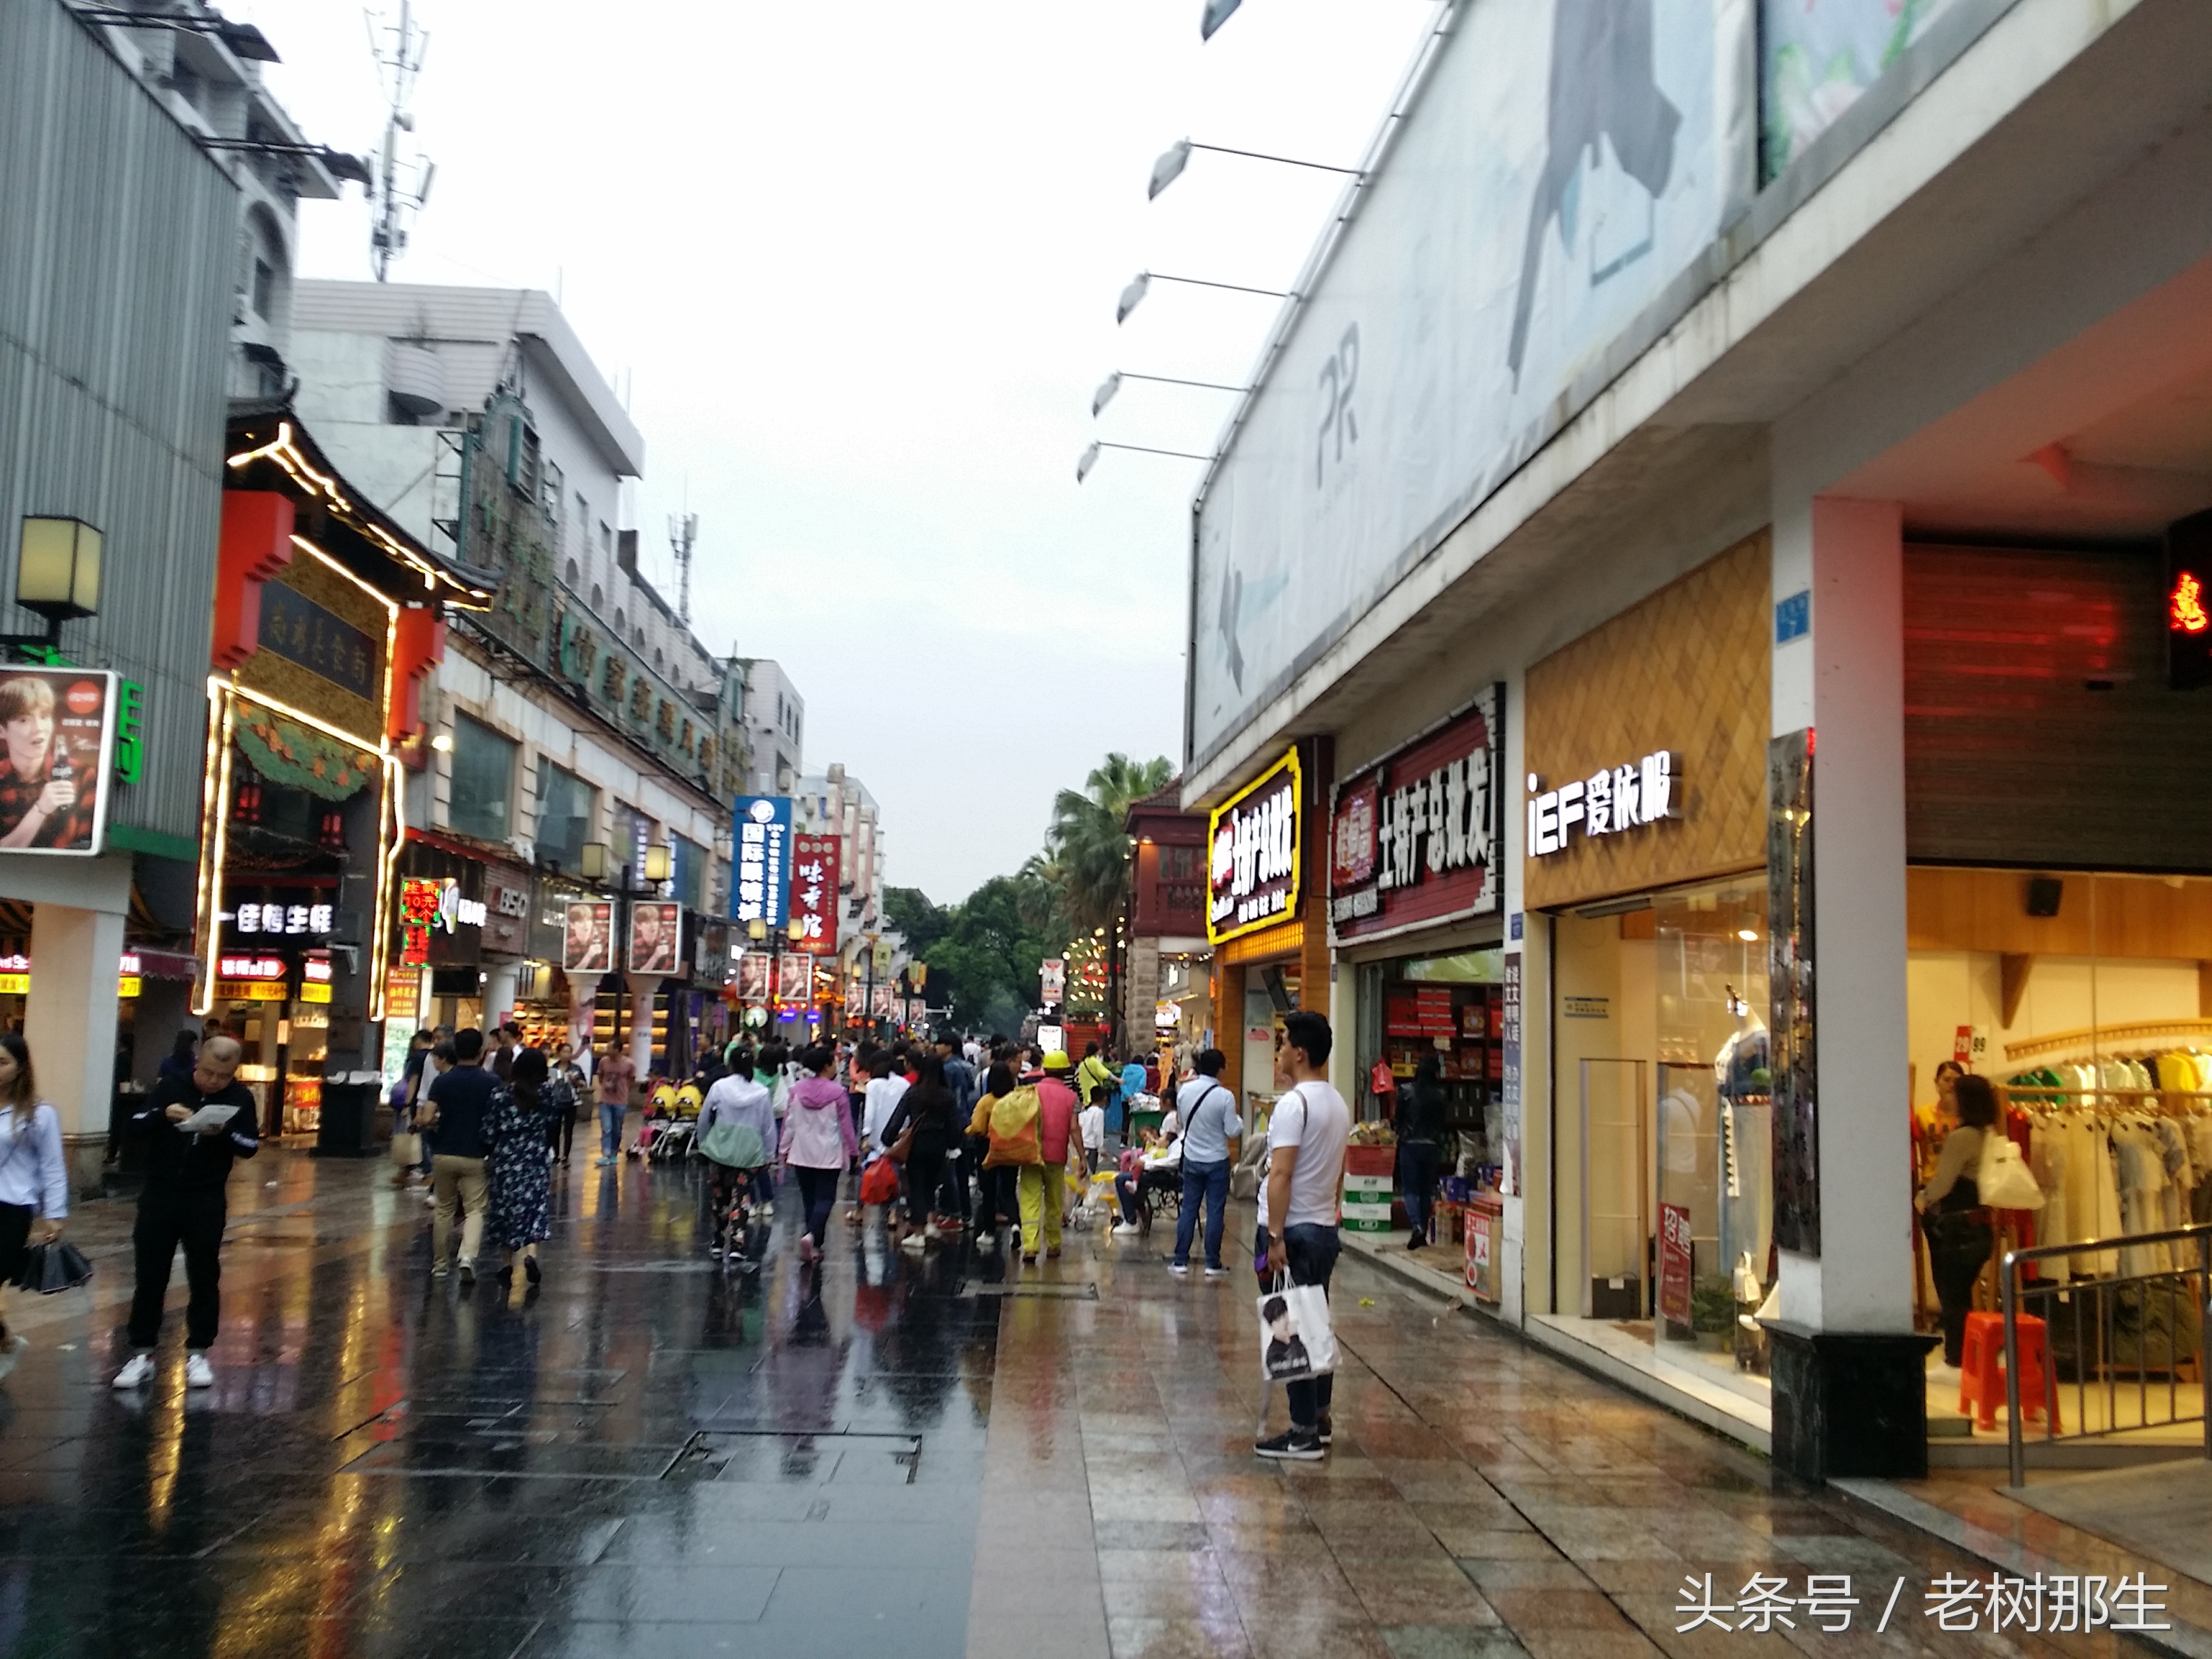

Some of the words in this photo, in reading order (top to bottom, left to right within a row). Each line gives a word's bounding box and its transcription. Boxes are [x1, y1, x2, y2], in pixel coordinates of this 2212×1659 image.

[1378, 747, 1489, 890] 土特产总批发
[1528, 773, 1584, 857] iEF
[1586, 750, 1671, 838] 爱依服
[1664, 1206, 1690, 1254] 招聘
